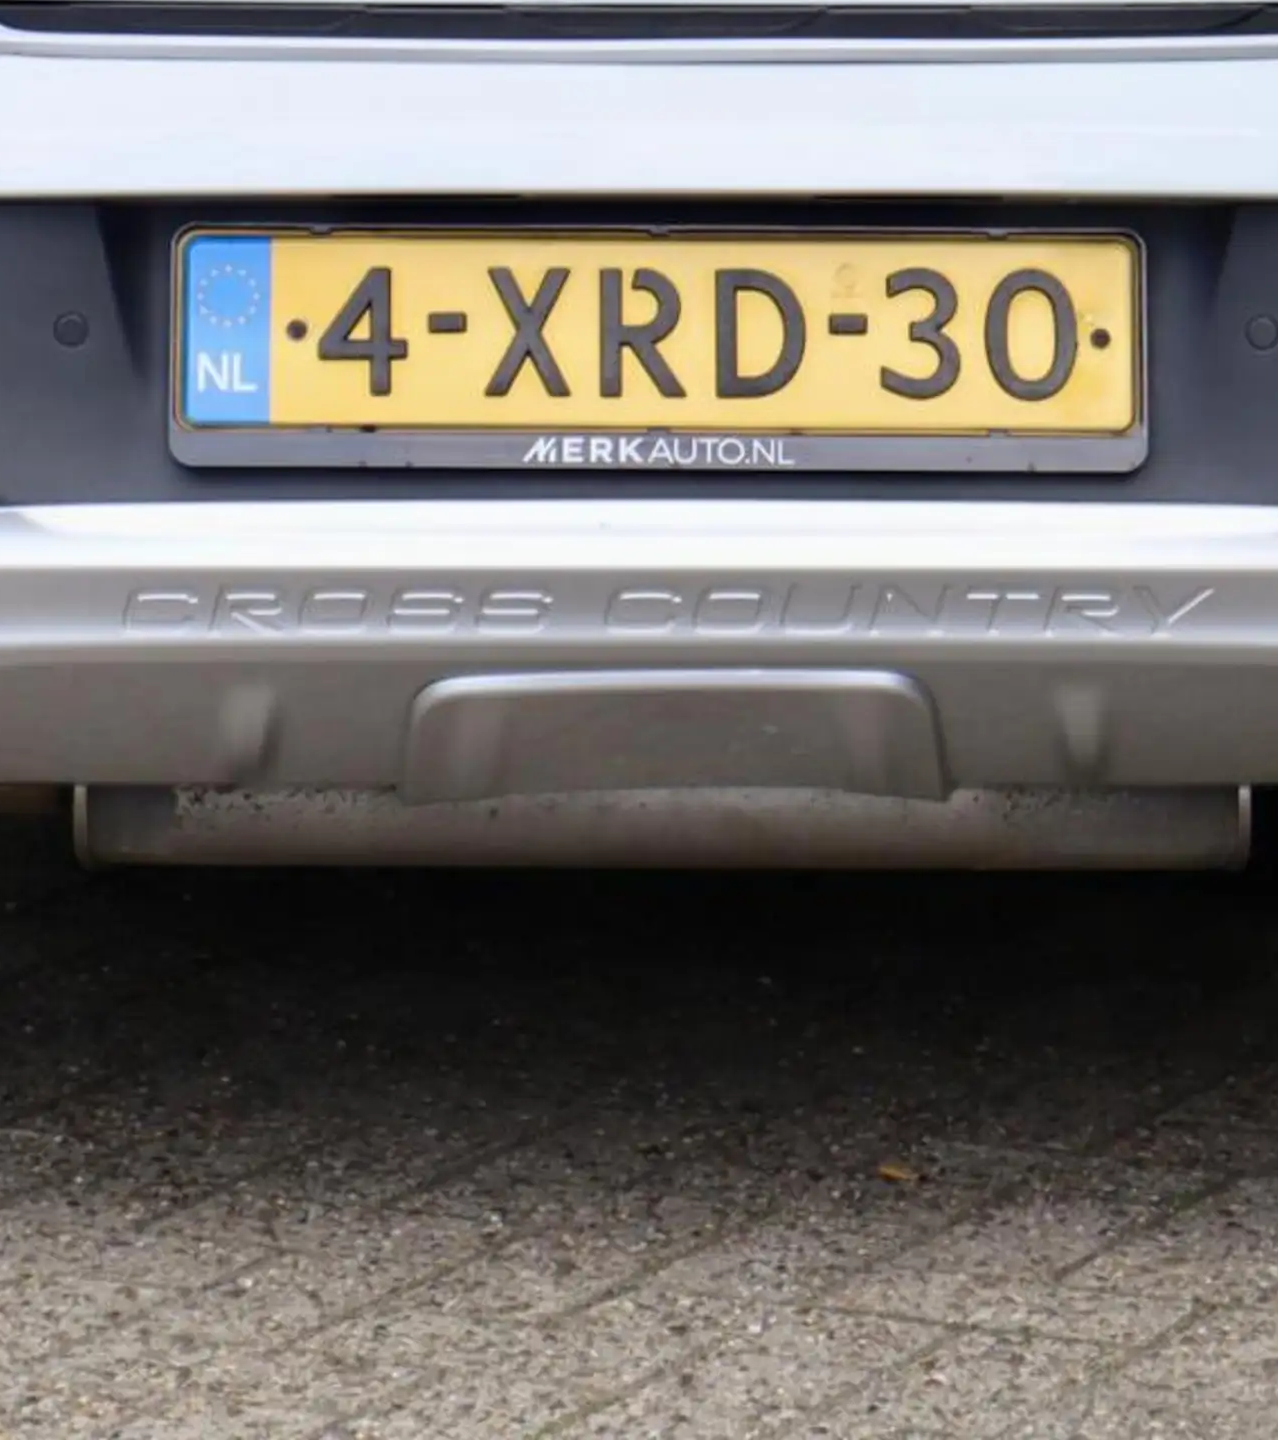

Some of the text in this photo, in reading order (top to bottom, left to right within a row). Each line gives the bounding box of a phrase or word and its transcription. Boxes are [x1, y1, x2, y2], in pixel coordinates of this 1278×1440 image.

[318, 266, 1079, 402] 4-XRD-30
[196, 352, 257, 394] NL
[123, 583, 1214, 636] CROSS COUNTRY
